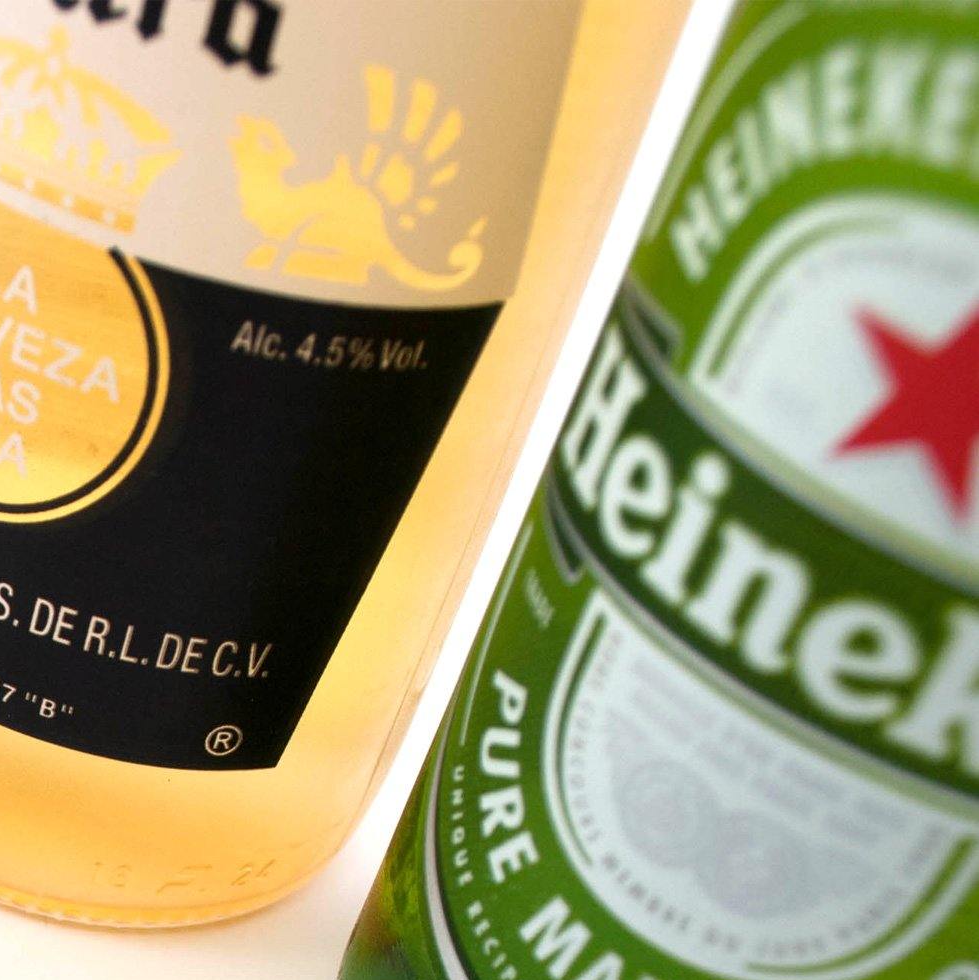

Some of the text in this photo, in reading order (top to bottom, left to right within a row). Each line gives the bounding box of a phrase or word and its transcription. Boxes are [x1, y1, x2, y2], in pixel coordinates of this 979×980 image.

[230, 319, 287, 361] Alc.
[379, 338, 428, 372] Vol.
[29, 597, 78, 645] DE
[83, 615, 148, 665] R.L.
[156, 633, 207, 674] DE
[213, 641, 272, 678] C.V.
[451, 765, 473, 886] UNIQUE
[479, 669, 540, 883] PURE
